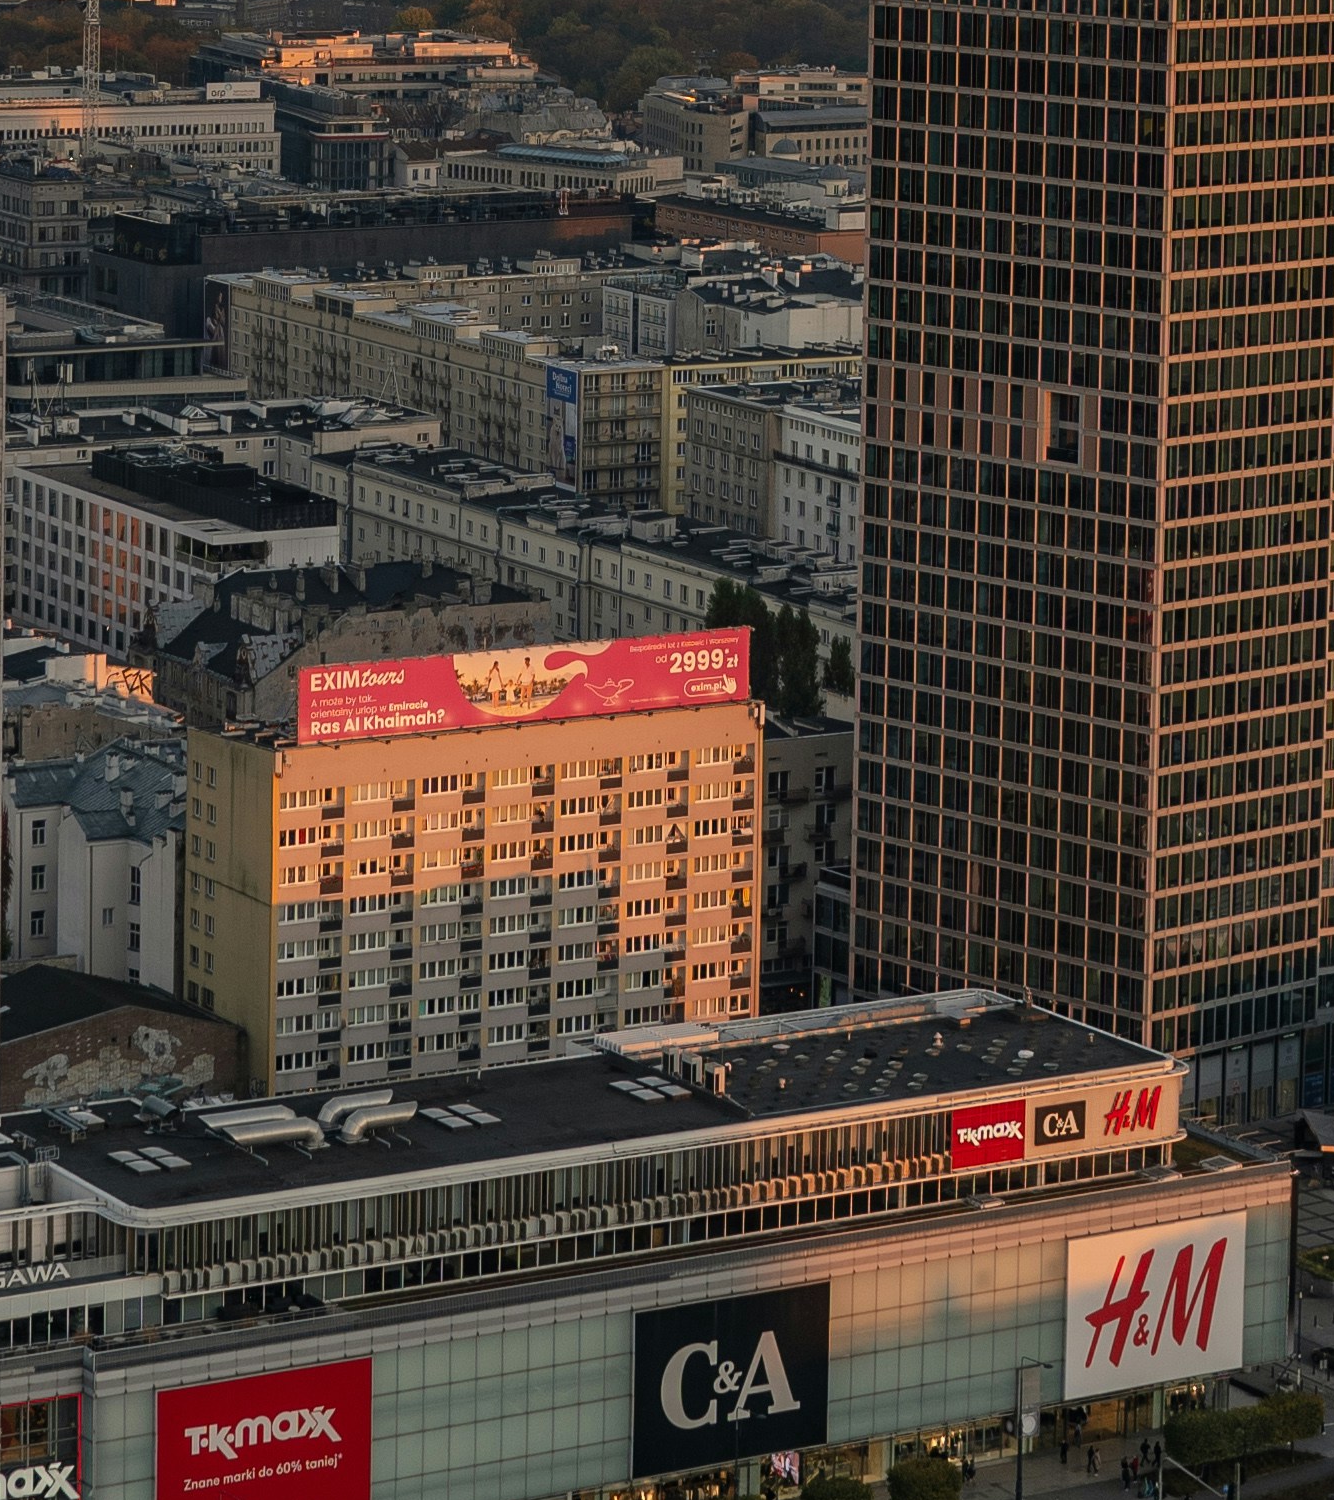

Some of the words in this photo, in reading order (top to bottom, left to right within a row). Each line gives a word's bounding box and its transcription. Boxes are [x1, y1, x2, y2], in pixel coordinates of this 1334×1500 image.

[311, 699, 318, 708] A
[345, 696, 357, 706] by
[310, 720, 341, 736] Ras
[363, 708, 445, 730] Khaimah?
[1043, 1110, 1079, 1137] C&A
[1104, 1085, 1162, 1136] H&M
[1084, 1237, 1228, 1368] H&M
[660, 1329, 801, 1430] C&A
[183, 1476, 220, 1492] Znane
[222, 1466, 257, 1486] marki
[258, 1465, 274, 1478] do
[275, 1459, 303, 1475] 60%
